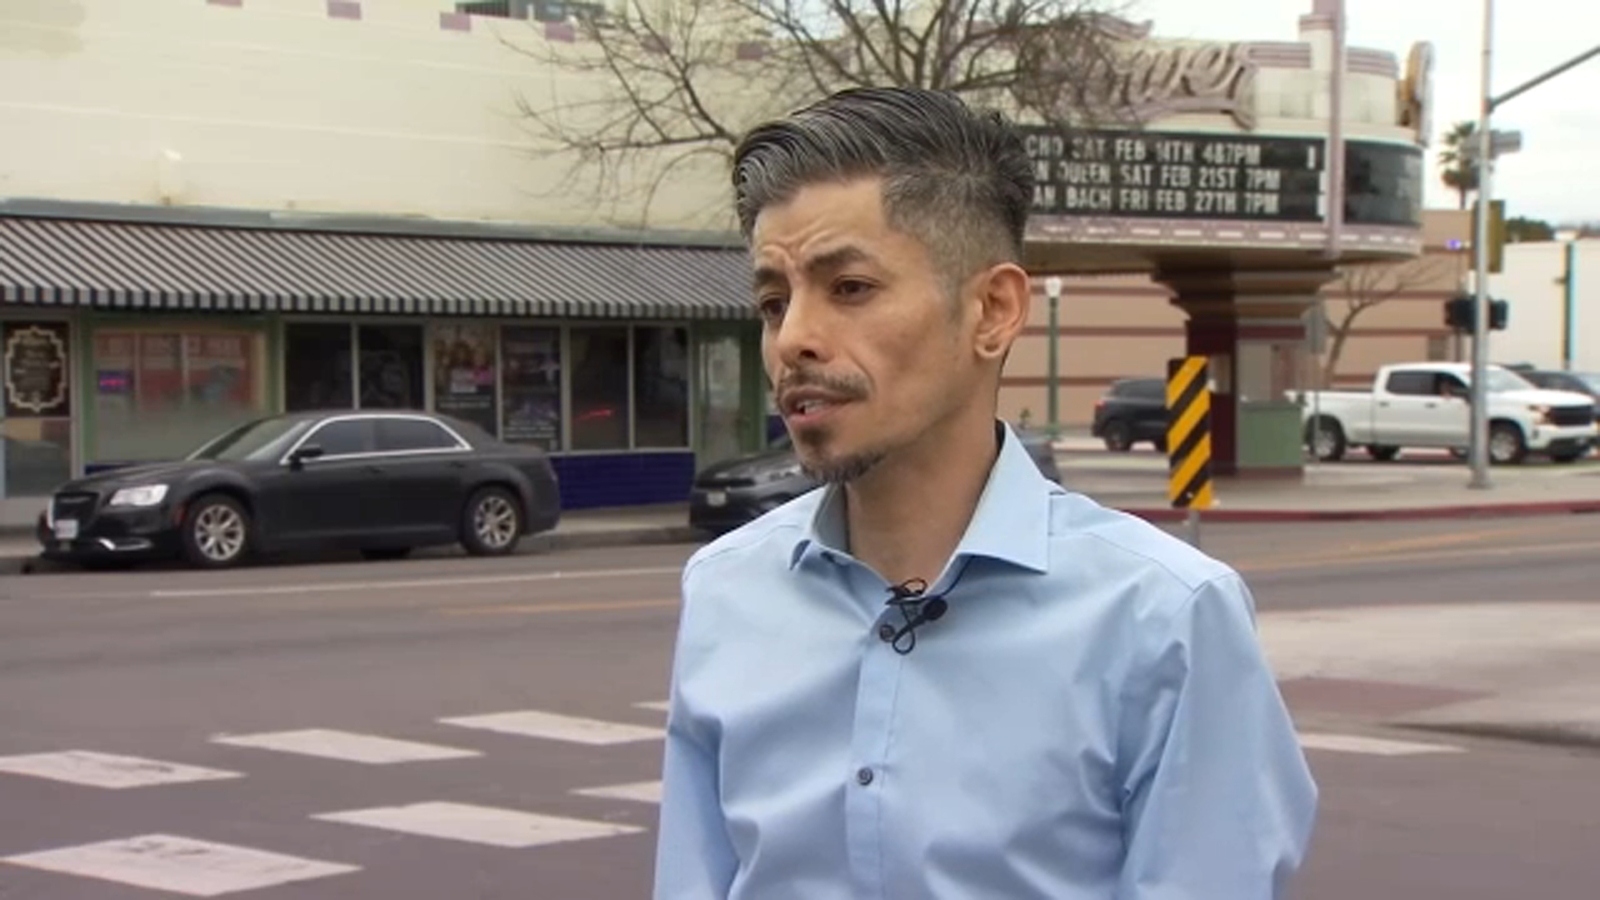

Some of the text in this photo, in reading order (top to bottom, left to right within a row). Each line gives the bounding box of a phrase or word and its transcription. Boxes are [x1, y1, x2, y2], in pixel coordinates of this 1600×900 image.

[1071, 137, 1106, 160] SAT
[1114, 138, 1146, 161] FEB
[1202, 143, 1261, 165] 4&7PM
[1031, 160, 1049, 181] N
[1120, 165, 1152, 185] SAT
[1161, 165, 1191, 188] FEB
[1199, 167, 1237, 189] 21ST
[1245, 167, 1281, 190] 7PM
[1066, 185, 1111, 209] BACH
[1119, 188, 1149, 210] FRI
[1156, 188, 1187, 211] FEB
[1195, 190, 1237, 214] 27TH
[1244, 191, 1280, 215] 7PM
